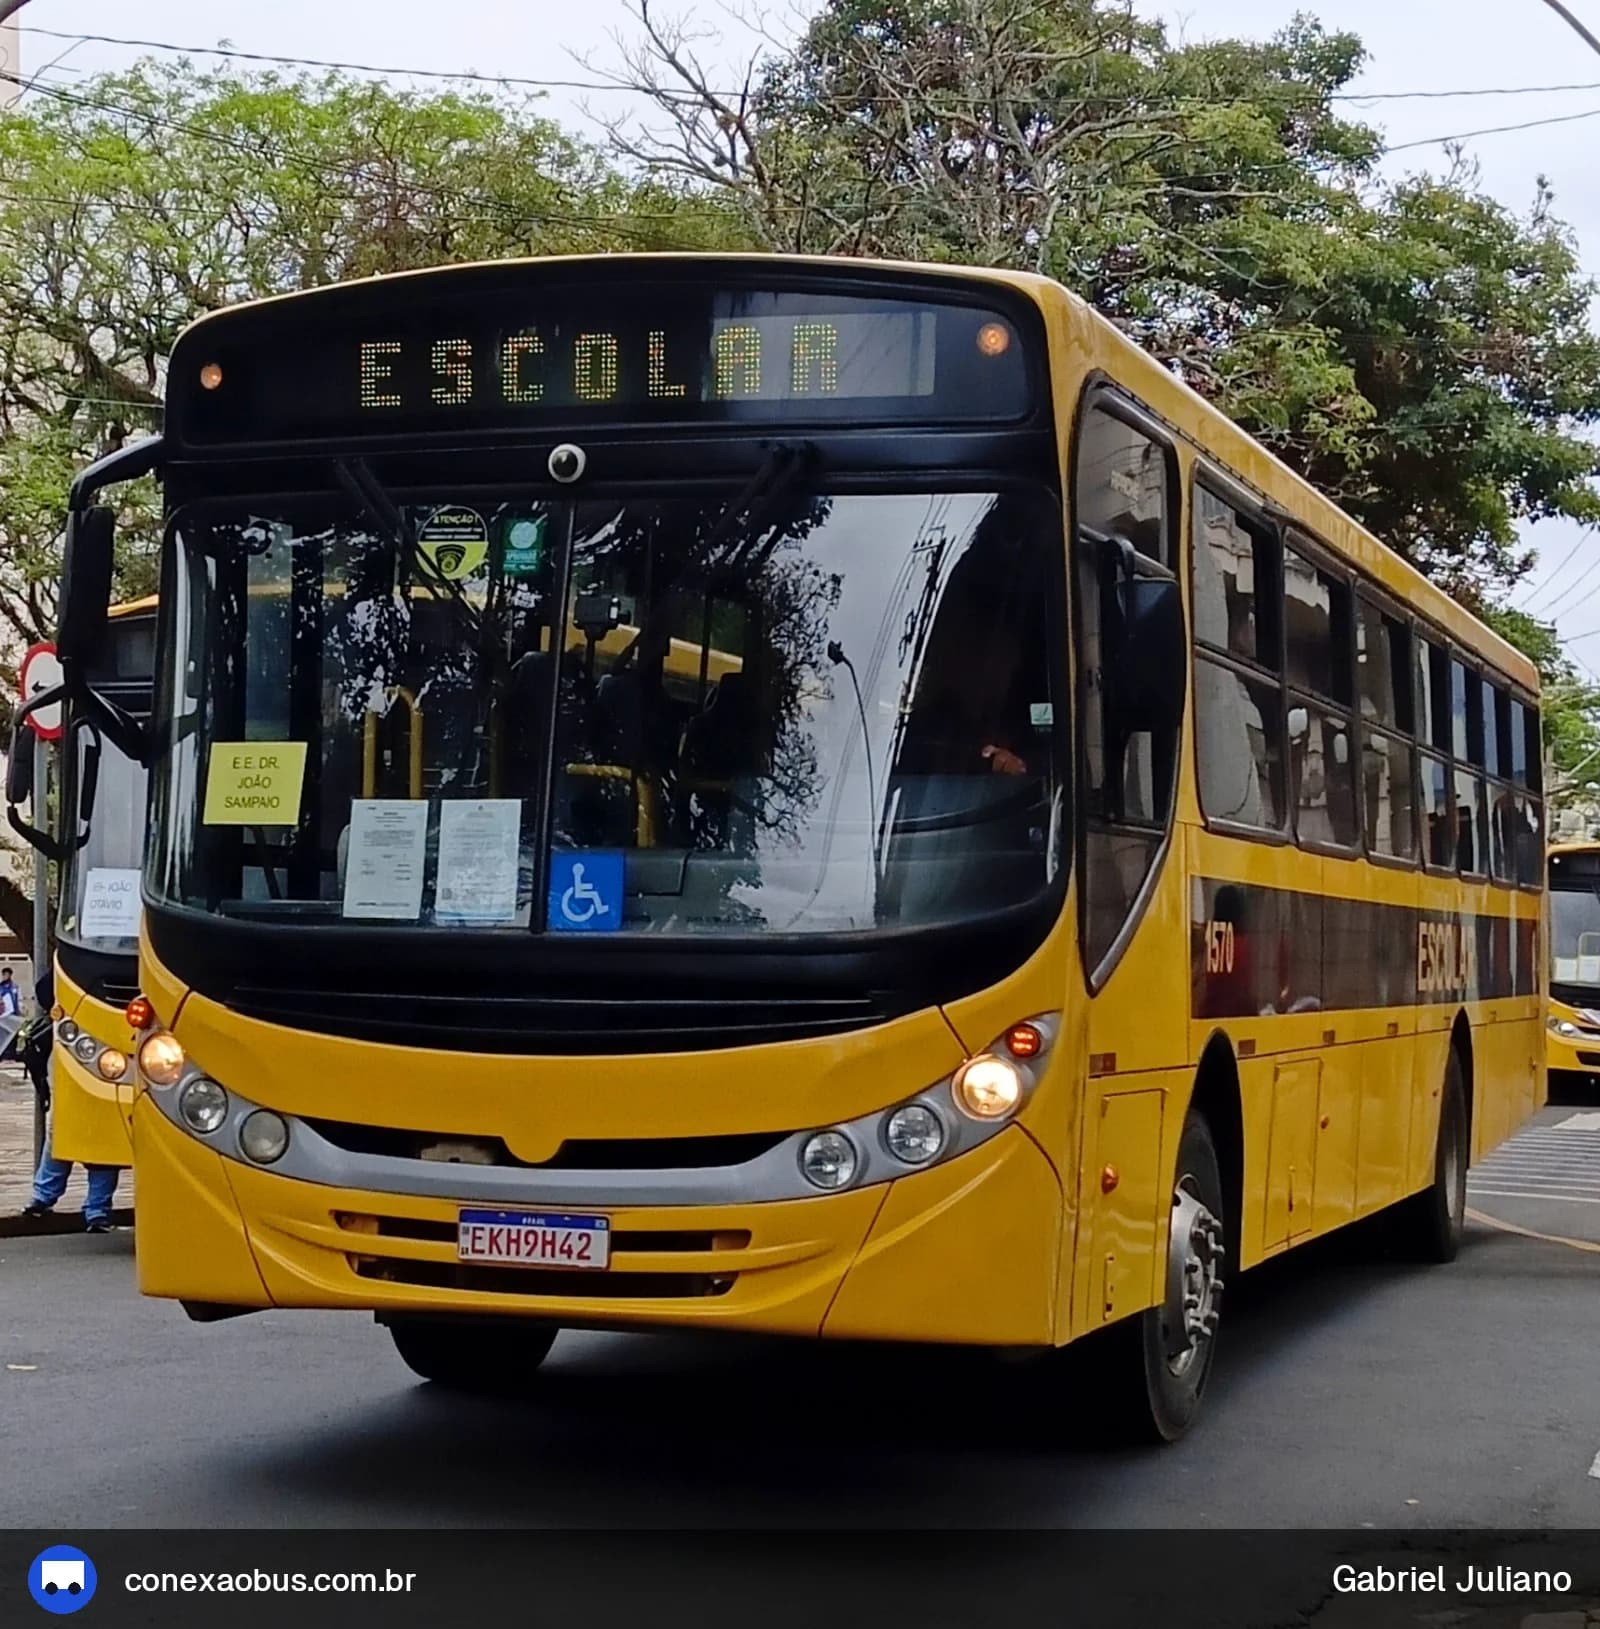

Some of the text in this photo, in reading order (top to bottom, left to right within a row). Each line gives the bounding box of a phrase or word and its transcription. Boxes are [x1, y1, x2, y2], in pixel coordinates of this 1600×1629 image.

[360, 323, 838, 407] ESCOLAR
[237, 774, 272, 789] JOÃO
[224, 796, 280, 808] SAMPAIO
[1205, 921, 1234, 974] 1570
[471, 1226, 592, 1261] EKH9H42
